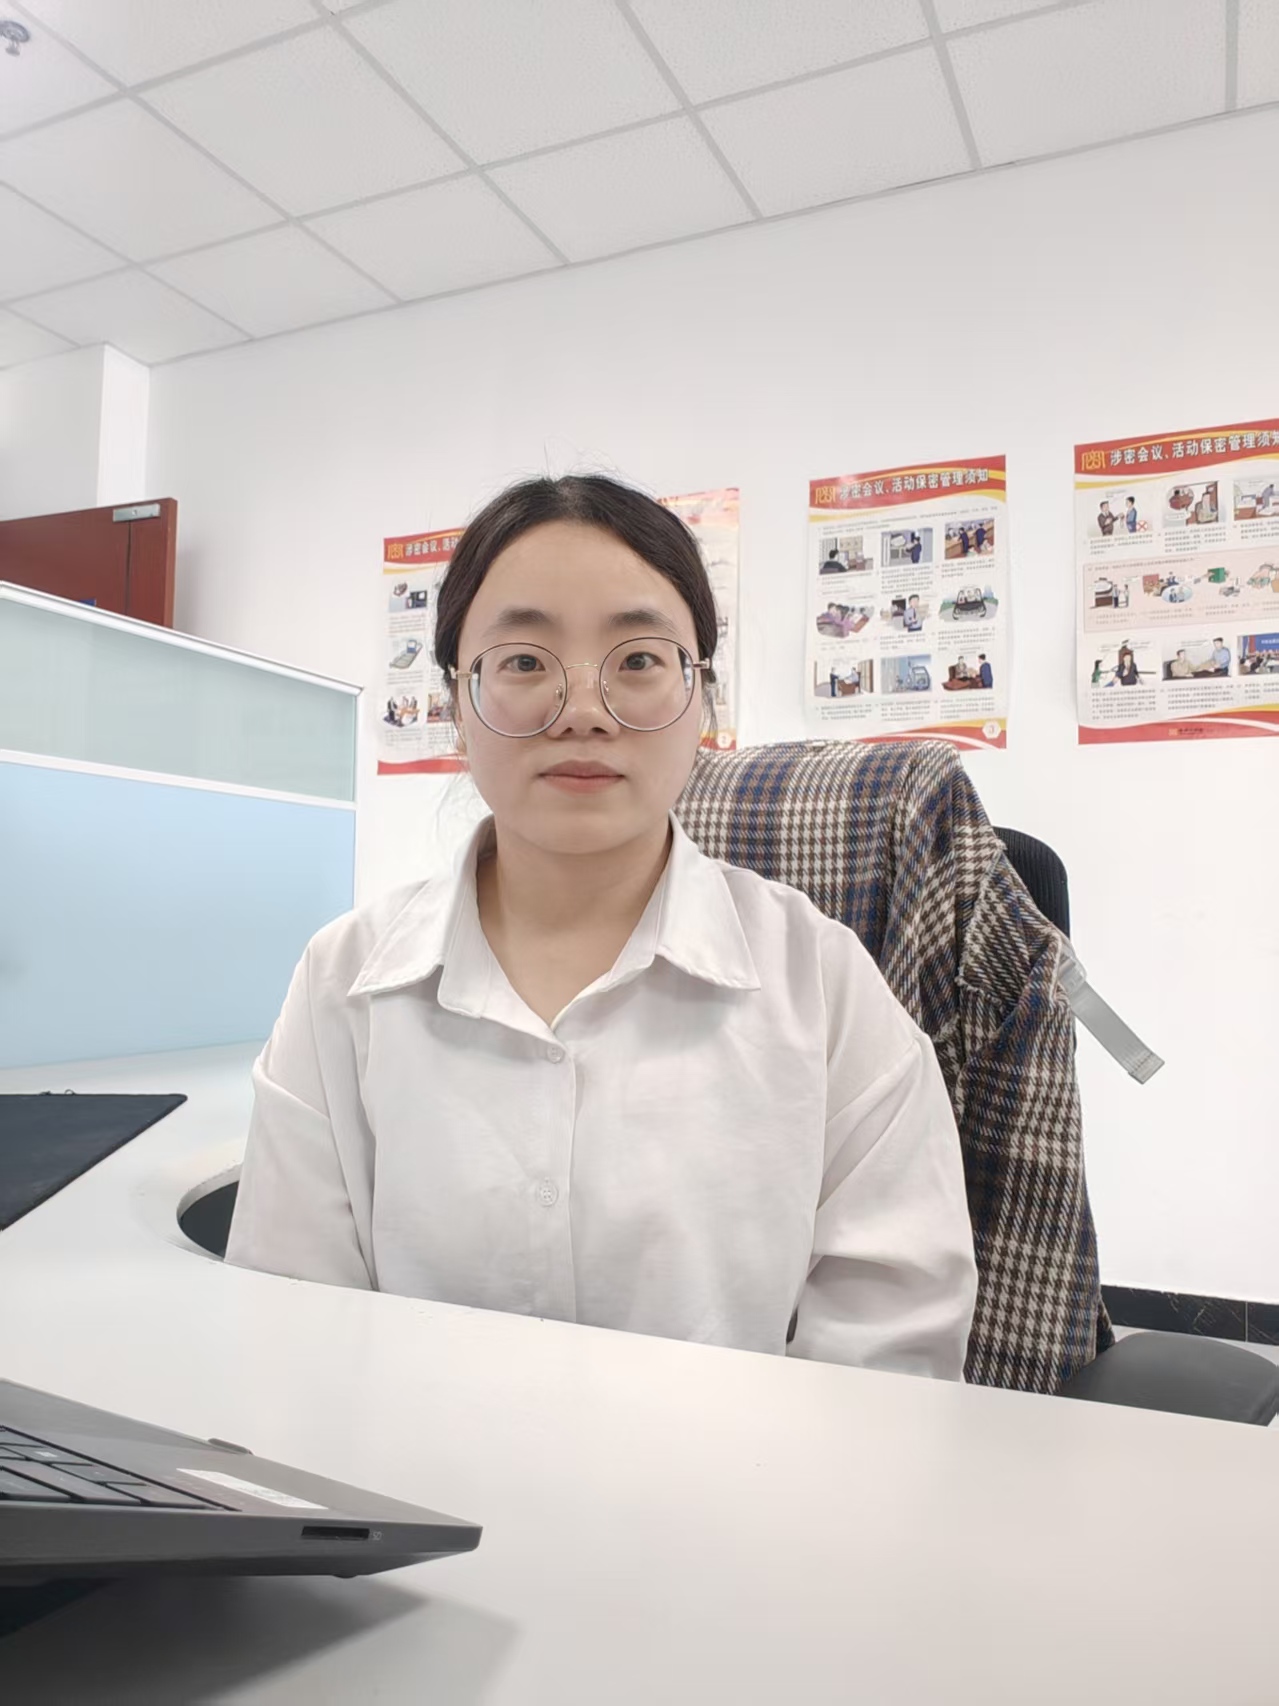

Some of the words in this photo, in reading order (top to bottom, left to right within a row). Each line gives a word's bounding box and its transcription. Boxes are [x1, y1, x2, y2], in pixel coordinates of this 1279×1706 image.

[839, 468, 989, 500] 涉密会议、活动保密管理须知
